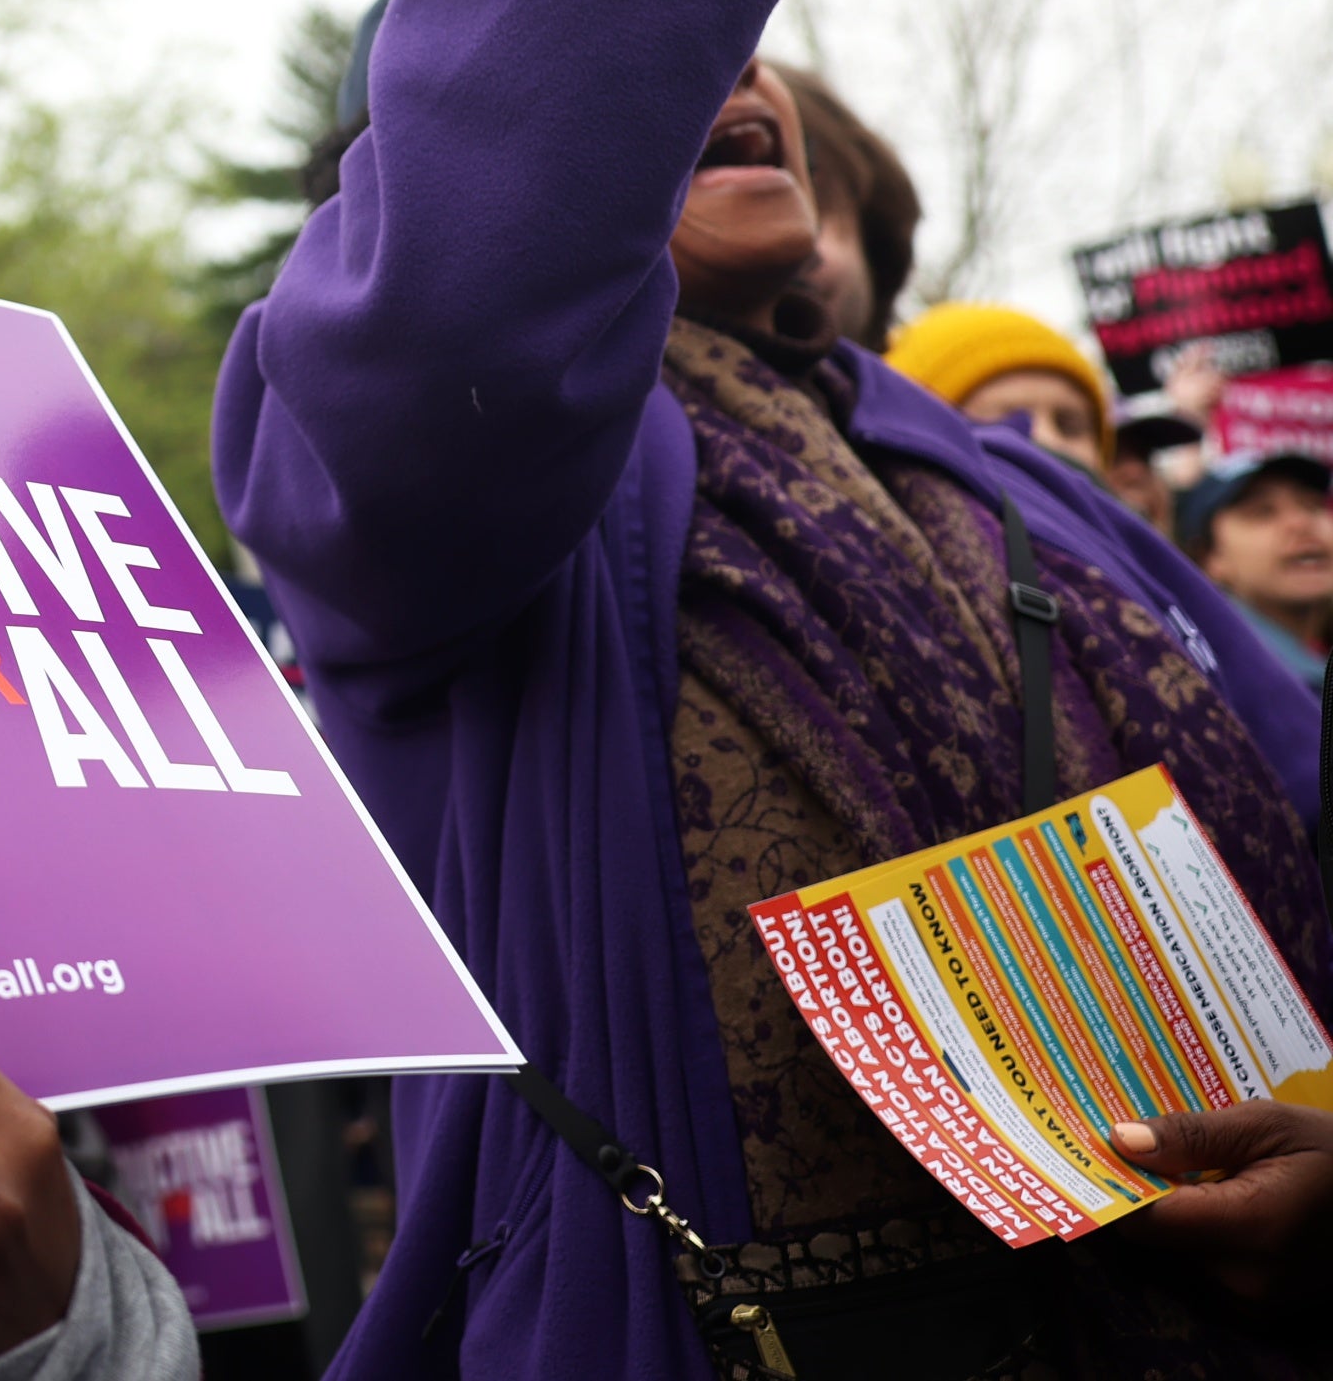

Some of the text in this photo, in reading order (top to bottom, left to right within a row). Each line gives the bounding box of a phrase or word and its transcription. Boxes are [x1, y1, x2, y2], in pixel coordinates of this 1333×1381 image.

[6, 624, 301, 799] ALL
[1087, 867, 1102, 884] IS
[1094, 805, 1153, 901] ABORTION?
[906, 879, 953, 956] KNOW
[968, 892, 982, 910] for
[1095, 880, 1135, 945] ABORTION
[1106, 876, 1129, 912] NEED
[980, 915, 1012, 967] approving
[1123, 909, 1143, 939] YOU
[1137, 937, 1150, 951] IF
[755, 907, 820, 1016] ABOUT
[806, 904, 872, 1012] ABOUT
[946, 954, 970, 989] TO
[1128, 941, 1176, 1022] MEDICATION
[1146, 900, 1211, 1010] MEDICATION
[780, 906, 881, 1071] ABORTION!
[832, 901, 932, 1065] ABORTION!
[989, 976, 1003, 994] THE
[998, 993, 1010, 1007] OF
[1005, 964, 1030, 1001] before
[1143, 949, 1185, 1018] AVAILABLE
[1224, 975, 1257, 1028] pregnant
[964, 989, 1005, 1051] NEED
[1004, 1004, 1022, 1029] TURN
[1023, 997, 1053, 1043] research
[1090, 1004, 1105, 1024] and
[1178, 1015, 1200, 1046] AND
[809, 1011, 885, 1108] FACTS
[860, 1008, 936, 1105] FACTS
[1047, 1040, 1060, 1055] of
[1054, 1052, 1076, 1083] years
[1091, 1023, 1118, 1064] Abortion
[1193, 1043, 1209, 1065] US
[1204, 1008, 1250, 1084] CHOOSE
[999, 1051, 1038, 1104] YOU
[1070, 1080, 1089, 1104] four
[1113, 1062, 1146, 1116] Medication
[1203, 1061, 1222, 1089] THE
[1215, 1086, 1230, 1104] IN
[875, 1103, 933, 1160] THE
[926, 1101, 985, 1156] THE
[1031, 1102, 1094, 1169] WHAT
[1083, 1102, 1104, 1127] over
[868, 1066, 1035, 1233] MEDICATION
[921, 1061, 1085, 1226] MEDICATION
[923, 1154, 1021, 1243] LEARN
[976, 1152, 1077, 1236] LEARN
